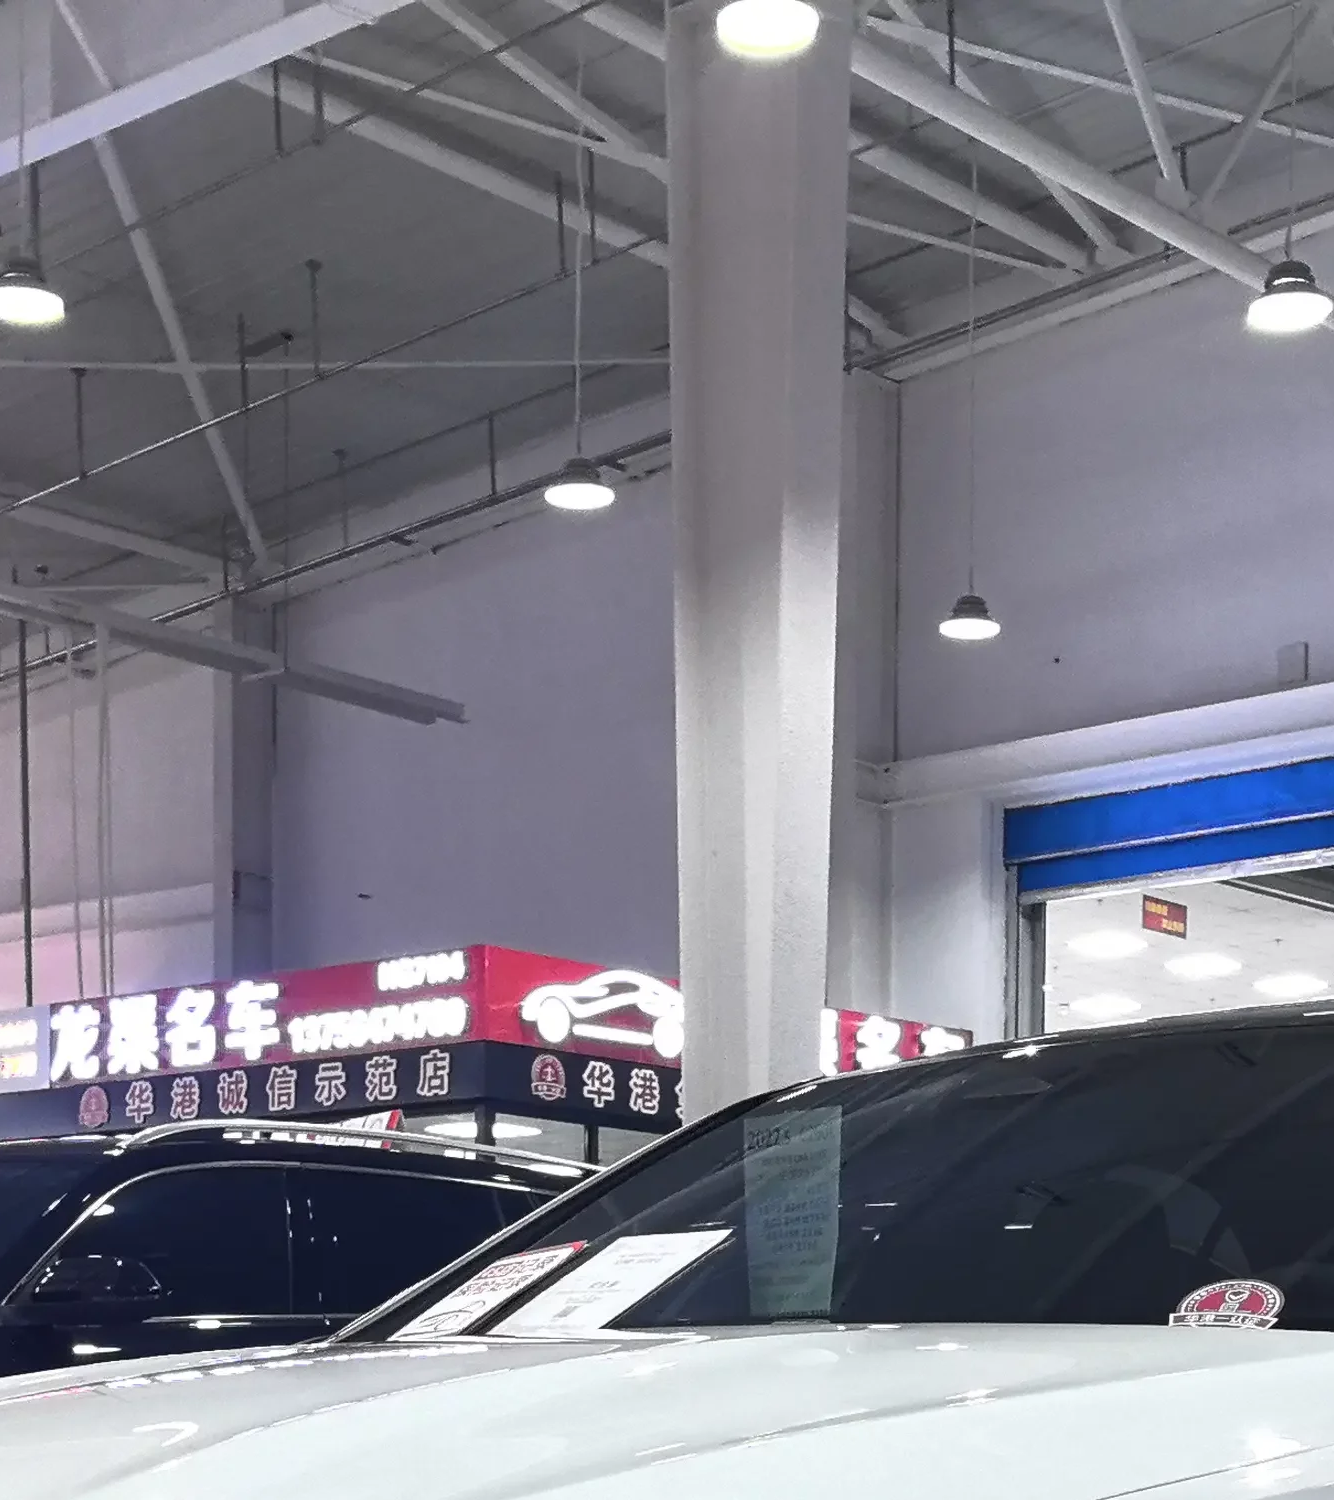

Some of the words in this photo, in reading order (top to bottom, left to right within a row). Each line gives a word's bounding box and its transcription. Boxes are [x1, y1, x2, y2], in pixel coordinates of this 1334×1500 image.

[125, 1049, 450, 1123] 华港诚信示范店
[583, 1060, 684, 1119] 华港
